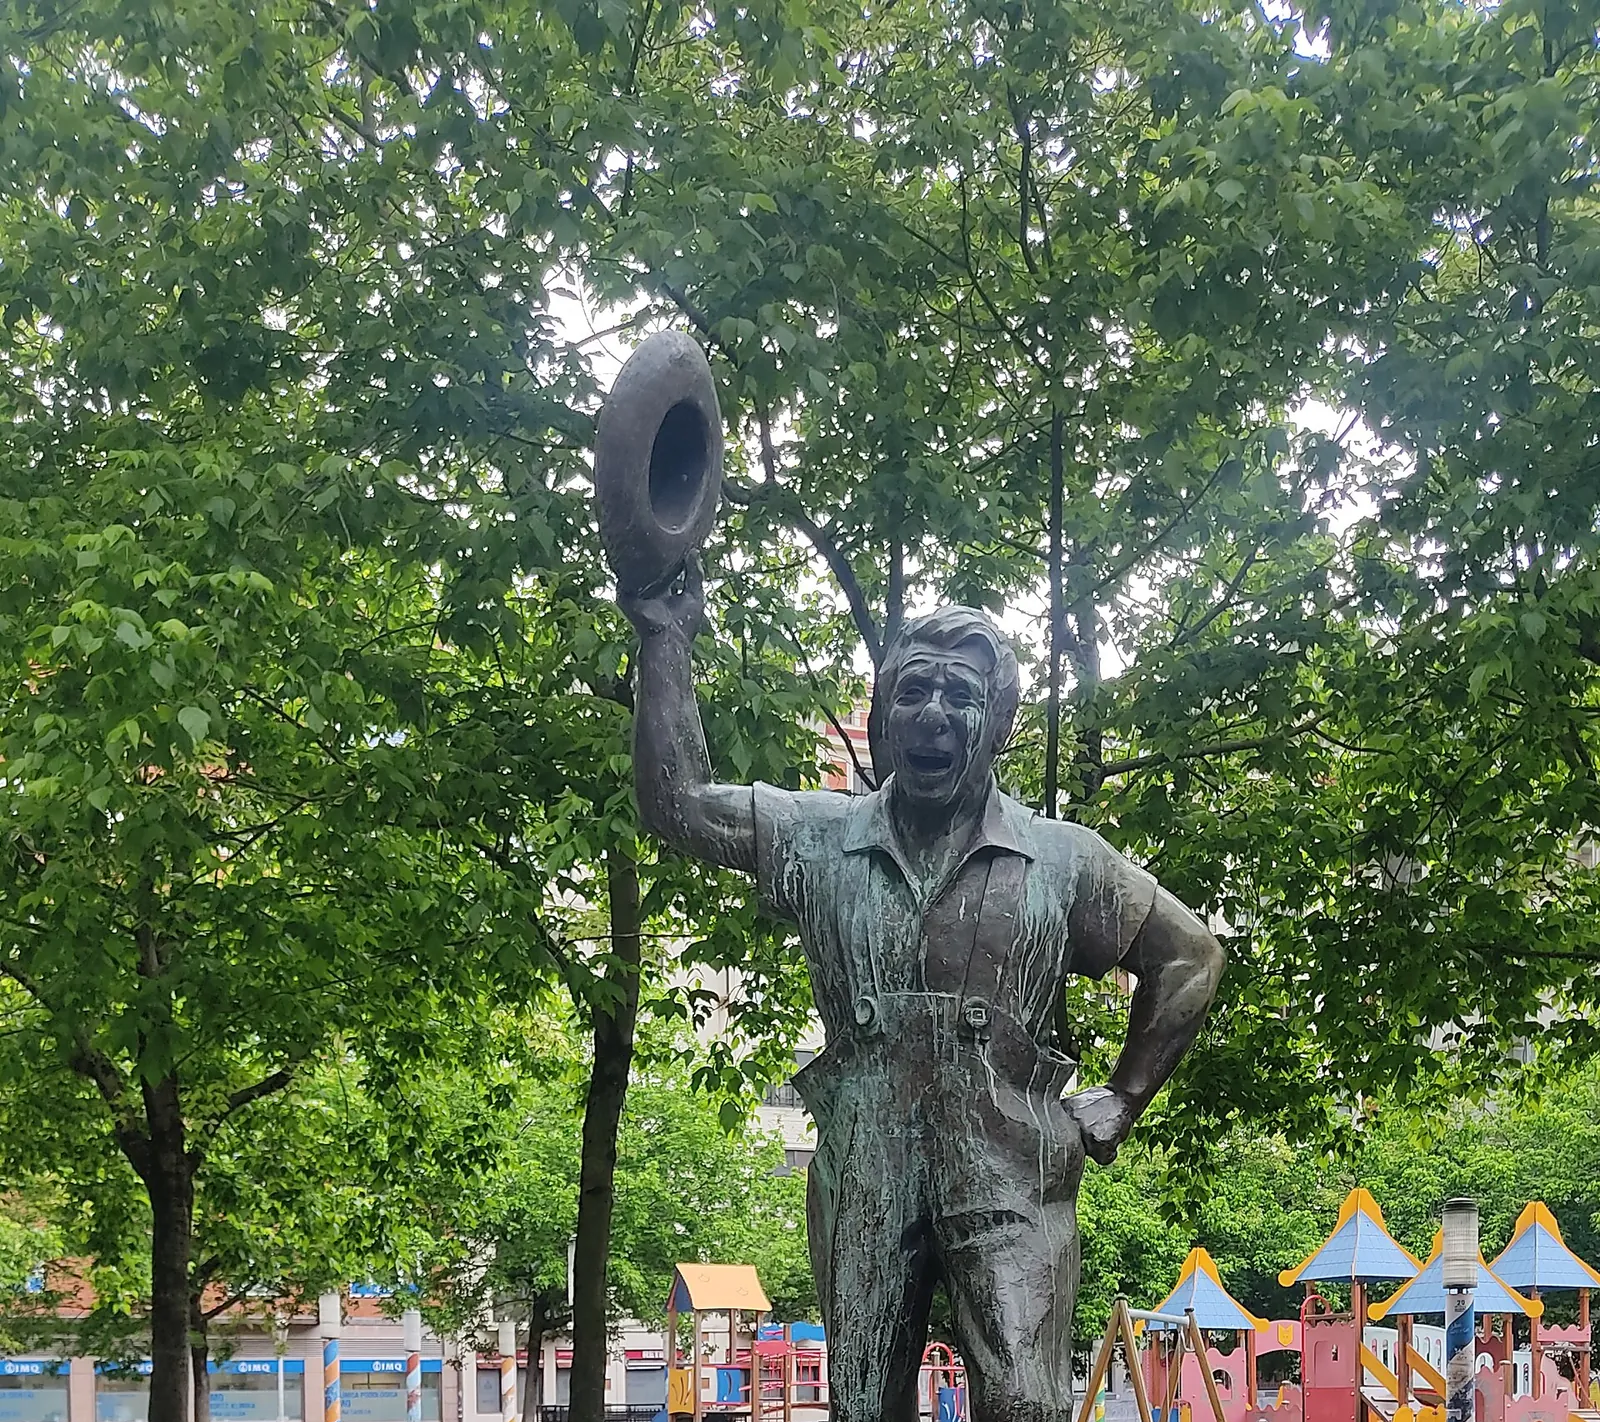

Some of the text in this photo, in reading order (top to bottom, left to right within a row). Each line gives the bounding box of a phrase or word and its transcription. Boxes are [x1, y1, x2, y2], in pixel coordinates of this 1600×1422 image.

[15, 1363, 40, 1374] IMQ
[248, 1363, 271, 1372] IMQ
[382, 1362, 403, 1372] IMQ
